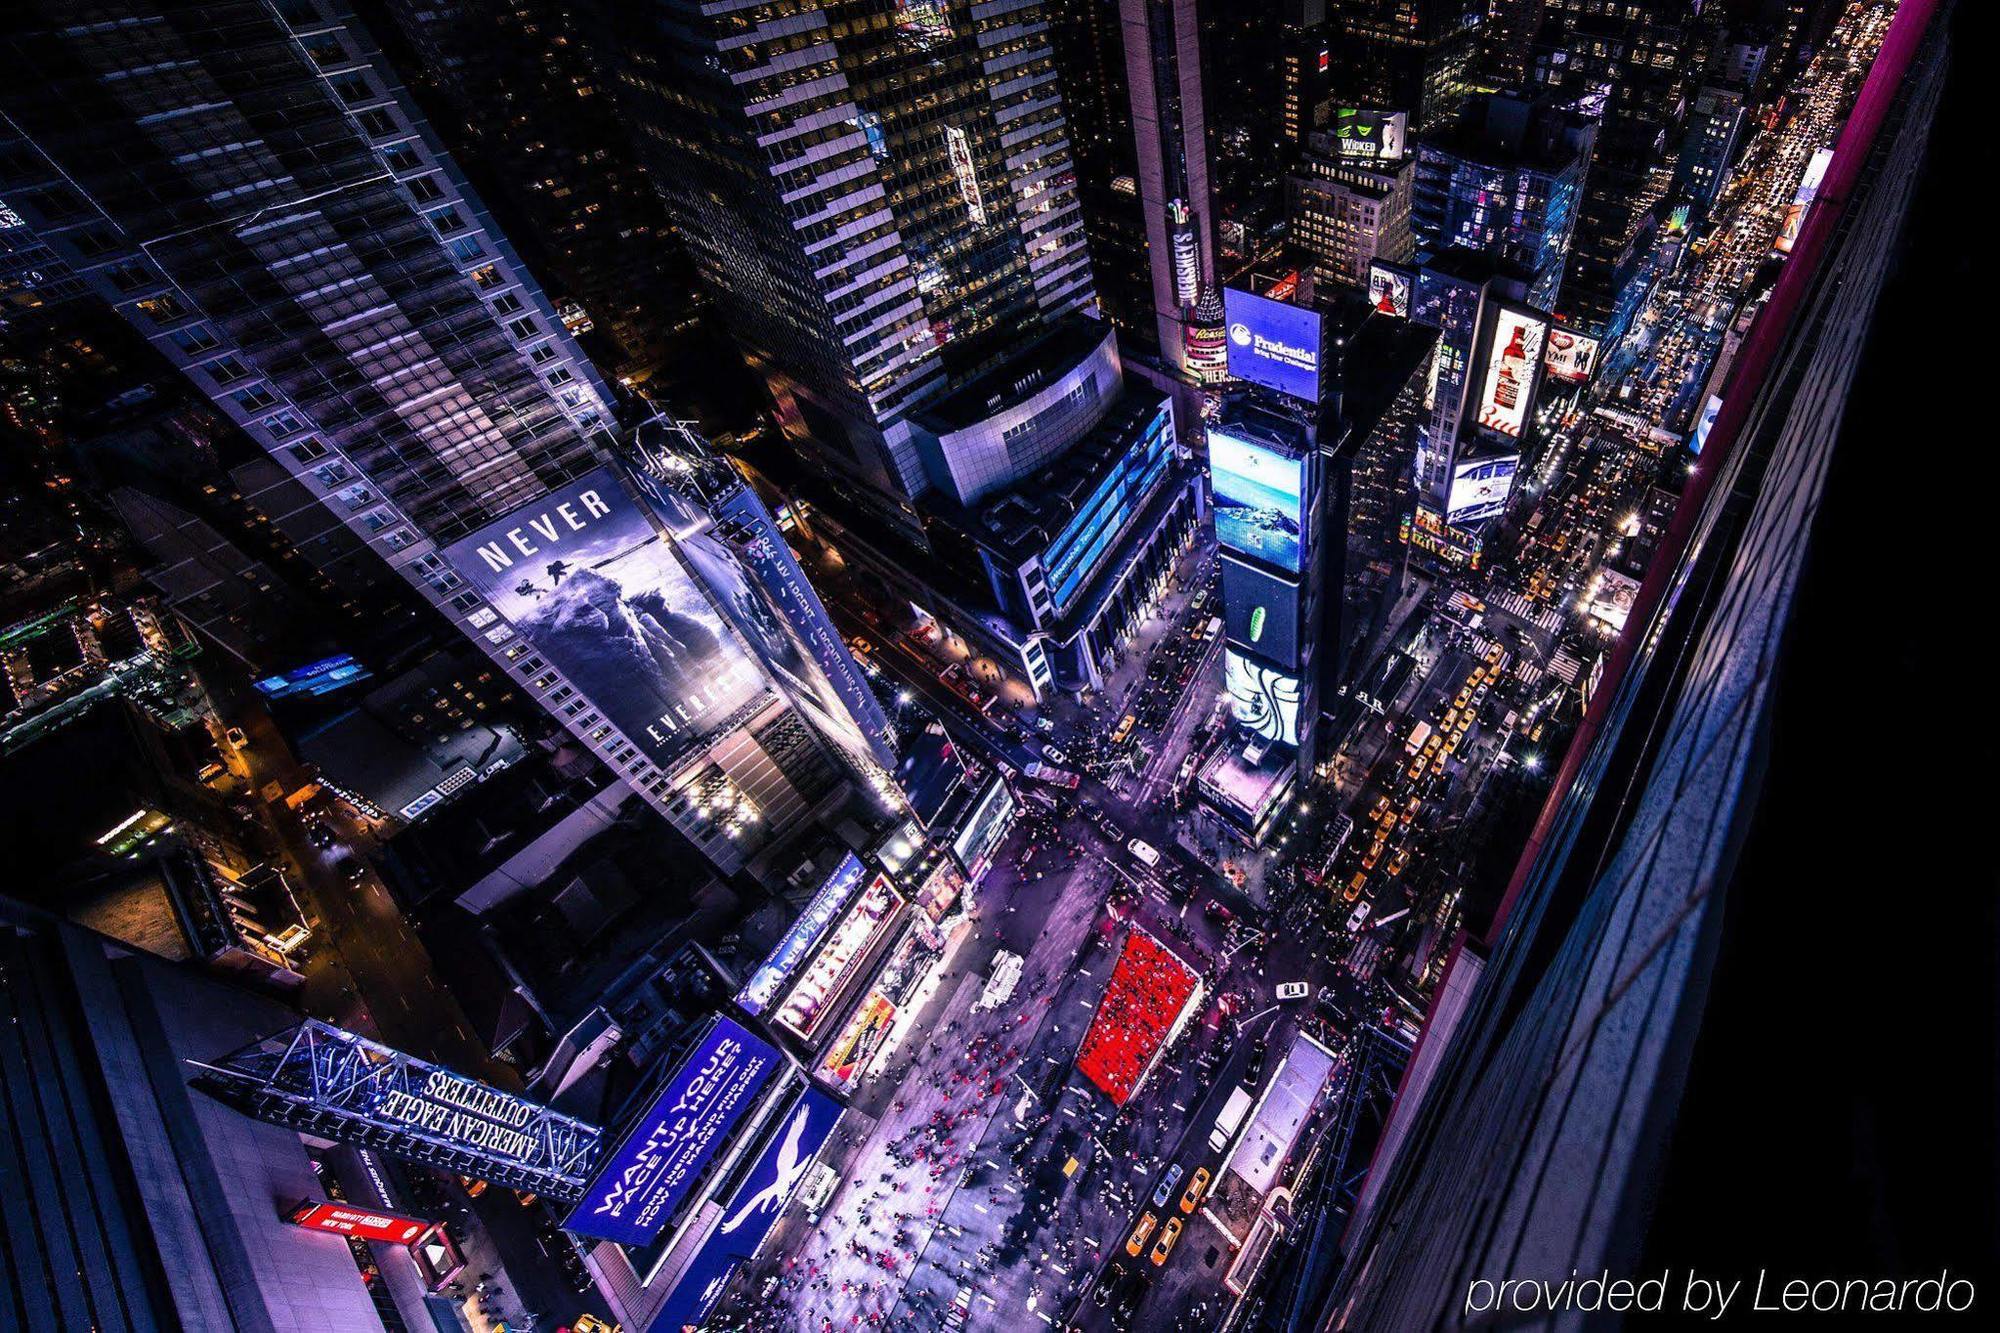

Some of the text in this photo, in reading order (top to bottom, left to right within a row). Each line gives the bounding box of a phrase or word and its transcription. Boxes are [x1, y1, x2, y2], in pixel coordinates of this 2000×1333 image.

[1173, 232, 1197, 300] HERSHEY'S
[1254, 334, 1317, 364] Prudential
[476, 489, 611, 573] NEVER
[380, 1089, 540, 1160] AMERICAN EAGLE
[423, 1070, 530, 1128] OUTFITTERS
[594, 1038, 735, 1214] WANT YOUR
[610, 1042, 742, 1217] FACE UP HERE?
[634, 1057, 757, 1226] COME INSIDE AND FIND OUT
[641, 1057, 766, 1227] HOW TO MAKE IT HAPPEN.
